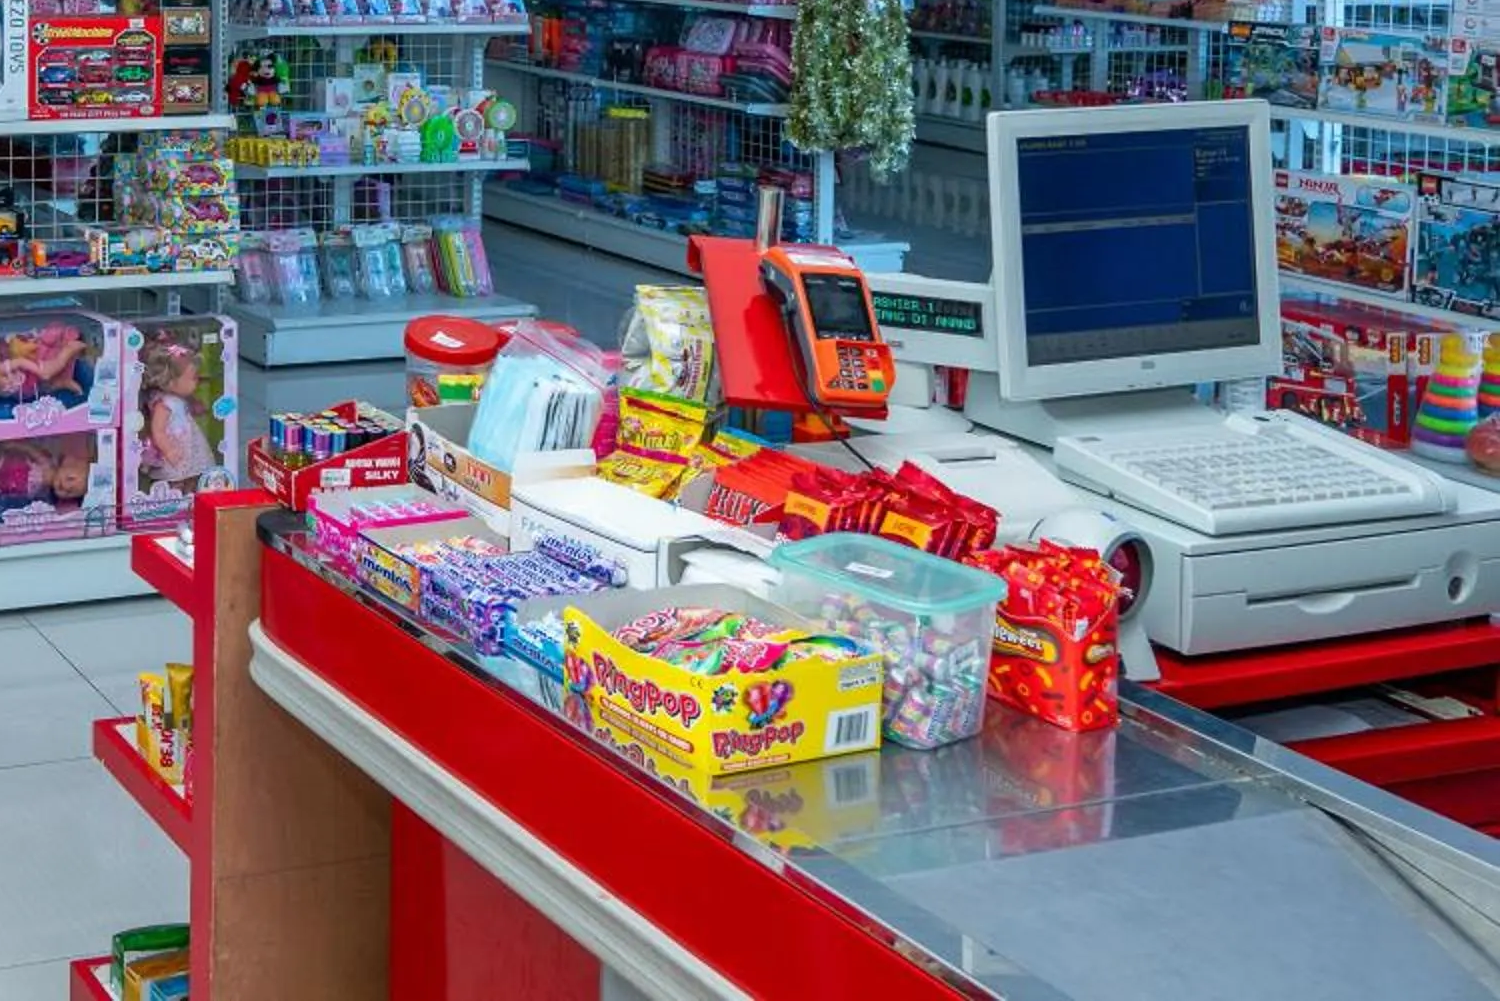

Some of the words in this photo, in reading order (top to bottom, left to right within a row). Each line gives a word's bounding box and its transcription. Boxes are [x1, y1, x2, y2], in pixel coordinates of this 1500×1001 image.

[873, 297, 920, 311] ASHIER
[364, 470, 400, 480] SILKY
[363, 555, 413, 593] mentos
